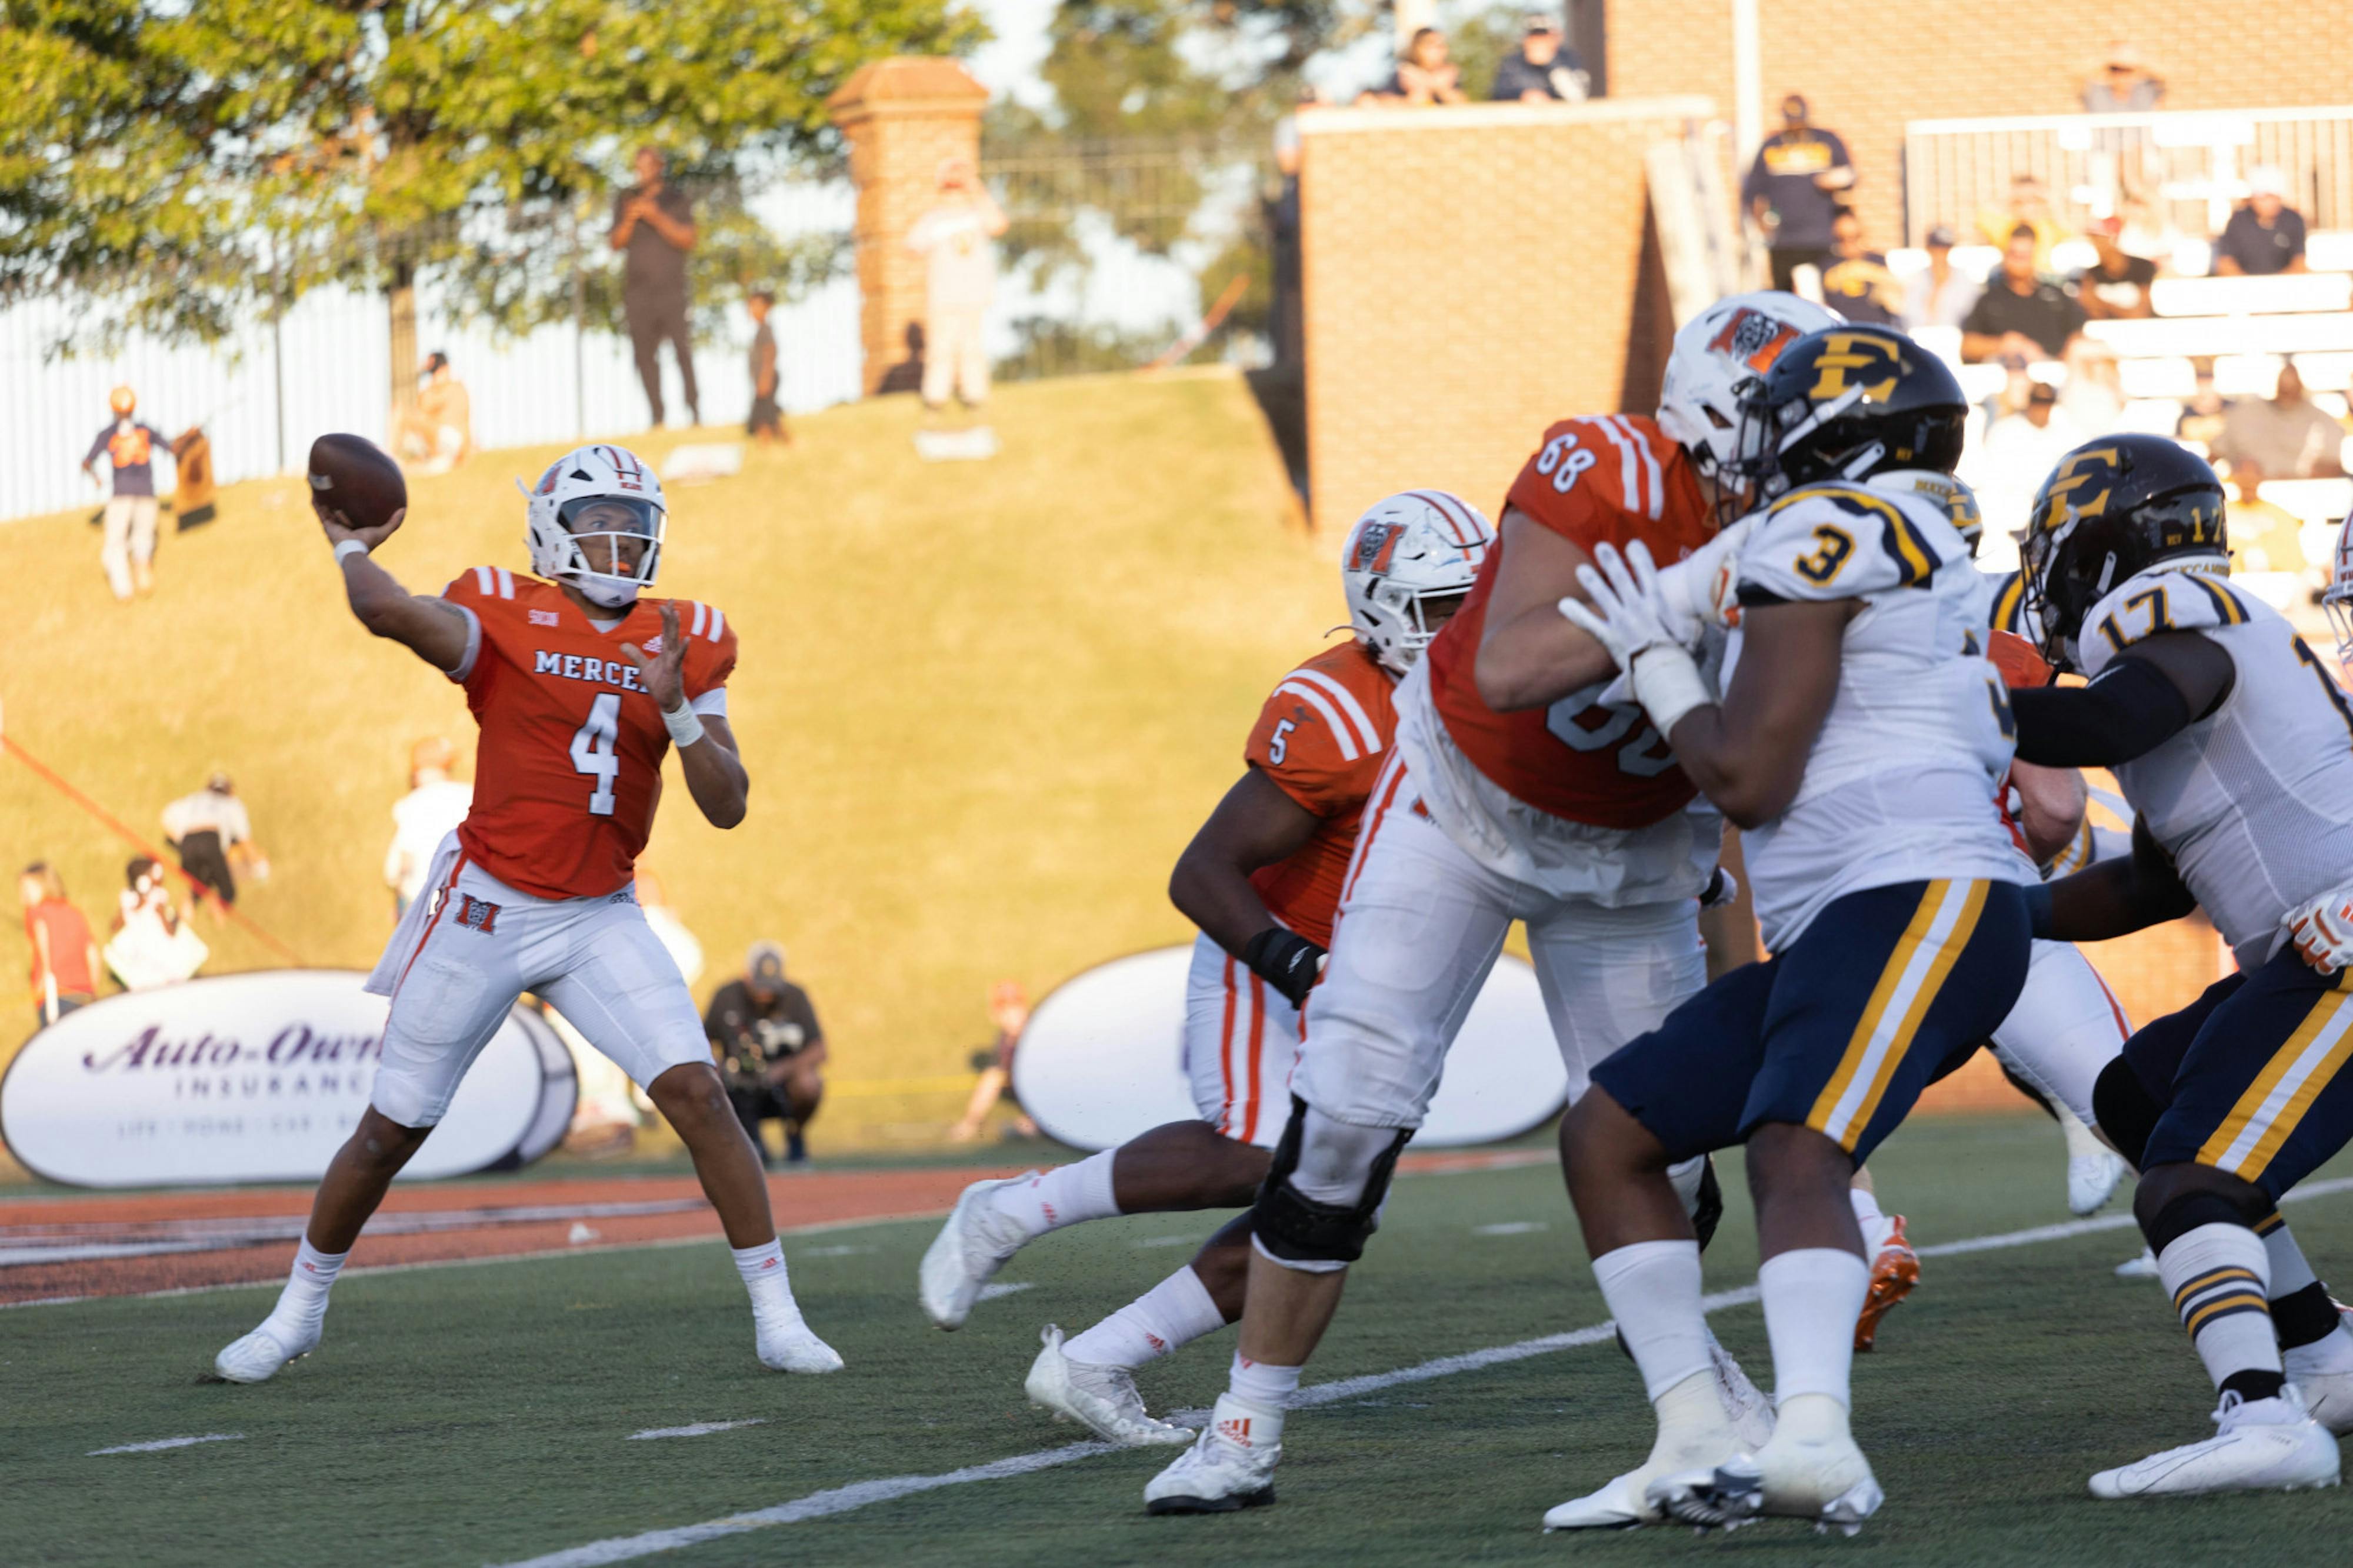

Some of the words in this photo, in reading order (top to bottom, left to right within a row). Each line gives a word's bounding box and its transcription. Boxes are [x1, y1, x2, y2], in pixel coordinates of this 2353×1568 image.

[1536, 432, 1597, 493] 68
[2190, 507, 2225, 543] 17
[1794, 522, 1858, 586] 3
[2098, 585, 2176, 654] 17
[535, 649, 649, 693] MERCE
[569, 692, 622, 816] 4
[1269, 718, 1295, 765] 5
[83, 1024, 384, 1070] Auto-Own
[175, 1073, 367, 1097] INSURANC
